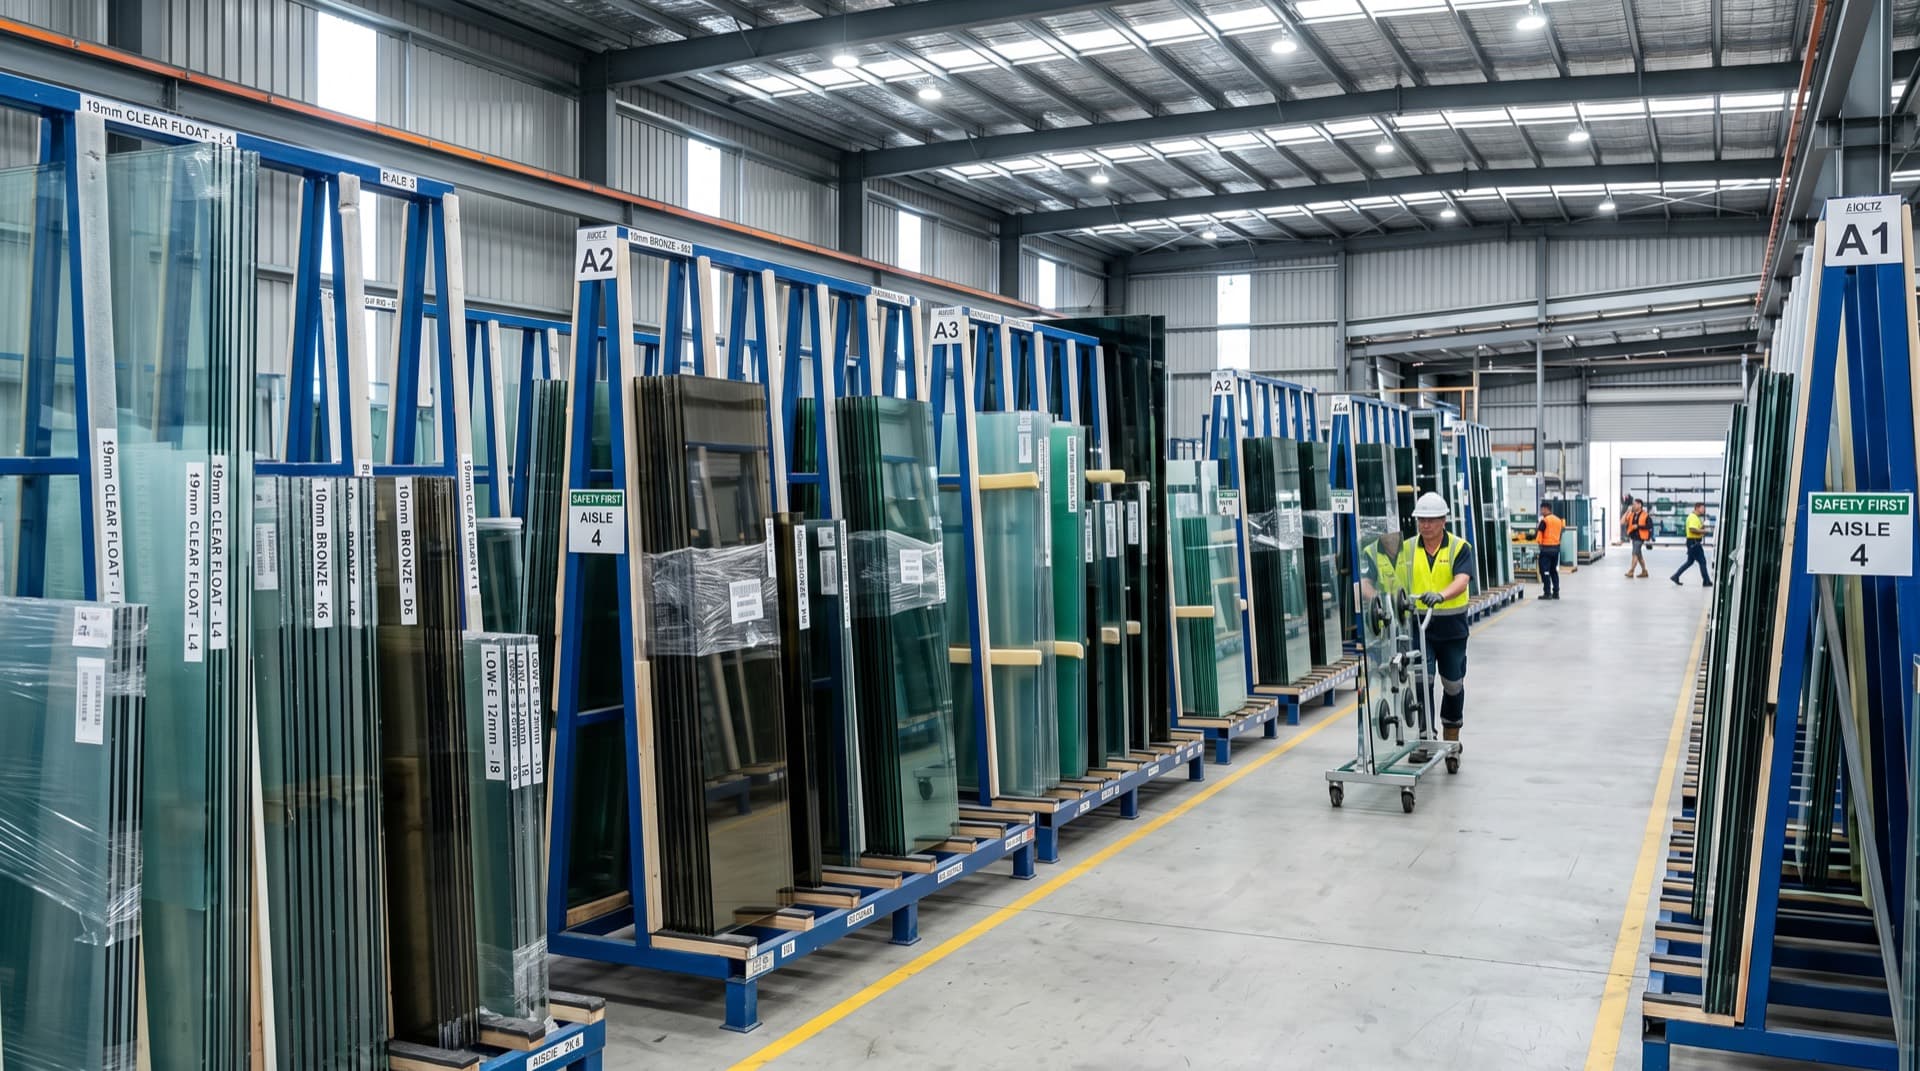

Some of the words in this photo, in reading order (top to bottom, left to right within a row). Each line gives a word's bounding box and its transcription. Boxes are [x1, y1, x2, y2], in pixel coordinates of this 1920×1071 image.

[86, 100, 123, 119] 19mm
[126, 110, 168, 130] CLEAR
[171, 120, 210, 140] FLOAT
[630, 231, 648, 244] 10mm
[649, 235, 676, 250] BRONZE
[1835, 221, 1888, 257] A1
[580, 247, 613, 274] A2
[933, 321, 959, 340] A3
[1214, 380, 1231, 392] A2
[102, 440, 114, 480] 19mm
[189, 472, 201, 516] 19mm
[212, 463, 224, 505] 19mm
[572, 494, 600, 504] SAFETY
[600, 494, 621, 504] FIRST
[104, 483, 118, 527] CLEAR
[315, 487, 327, 528] 10mm
[399, 485, 409, 525] 10mm
[465, 494, 475, 529] CLEAR
[580, 511, 614, 524] AISLE
[1814, 498, 1865, 511] SAFETY
[1868, 498, 1906, 511] FIRST
[189, 521, 200, 567] CLEAR
[211, 510, 223, 556] CLEAR
[591, 528, 602, 547] 4
[1829, 520, 1891, 537] AISLE
[106, 530, 120, 579] FLOAT
[316, 532, 328, 587] BRONZE
[400, 530, 413, 584] BRONZE
[1850, 543, 1869, 567] 4
[188, 571, 200, 618] FLOAT
[211, 560, 223, 607] FLOAT
[211, 621, 222, 638] L4
[317, 602, 328, 619] K6
[188, 634, 199, 651] L4
[486, 650, 498, 697] LOW-E
[487, 704, 498, 745] 12mm
